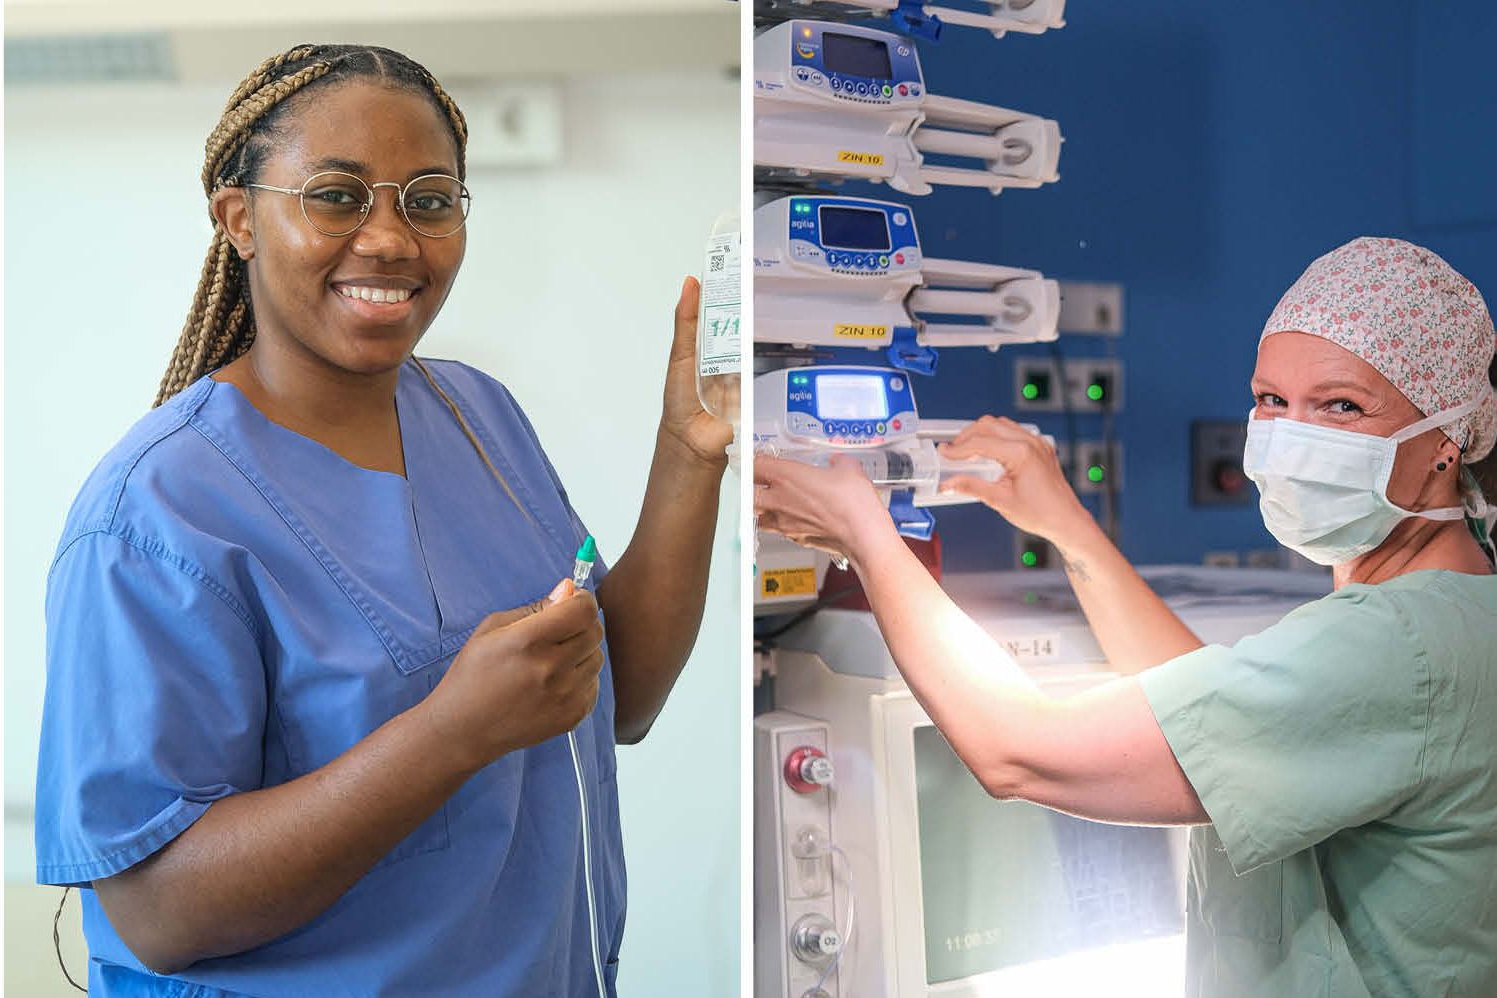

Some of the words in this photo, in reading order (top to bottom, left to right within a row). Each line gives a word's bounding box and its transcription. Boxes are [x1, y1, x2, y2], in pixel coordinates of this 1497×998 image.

[842, 152, 863, 163] ZIN
[838, 326, 864, 336] ZIN
[871, 327, 885, 336] 10
